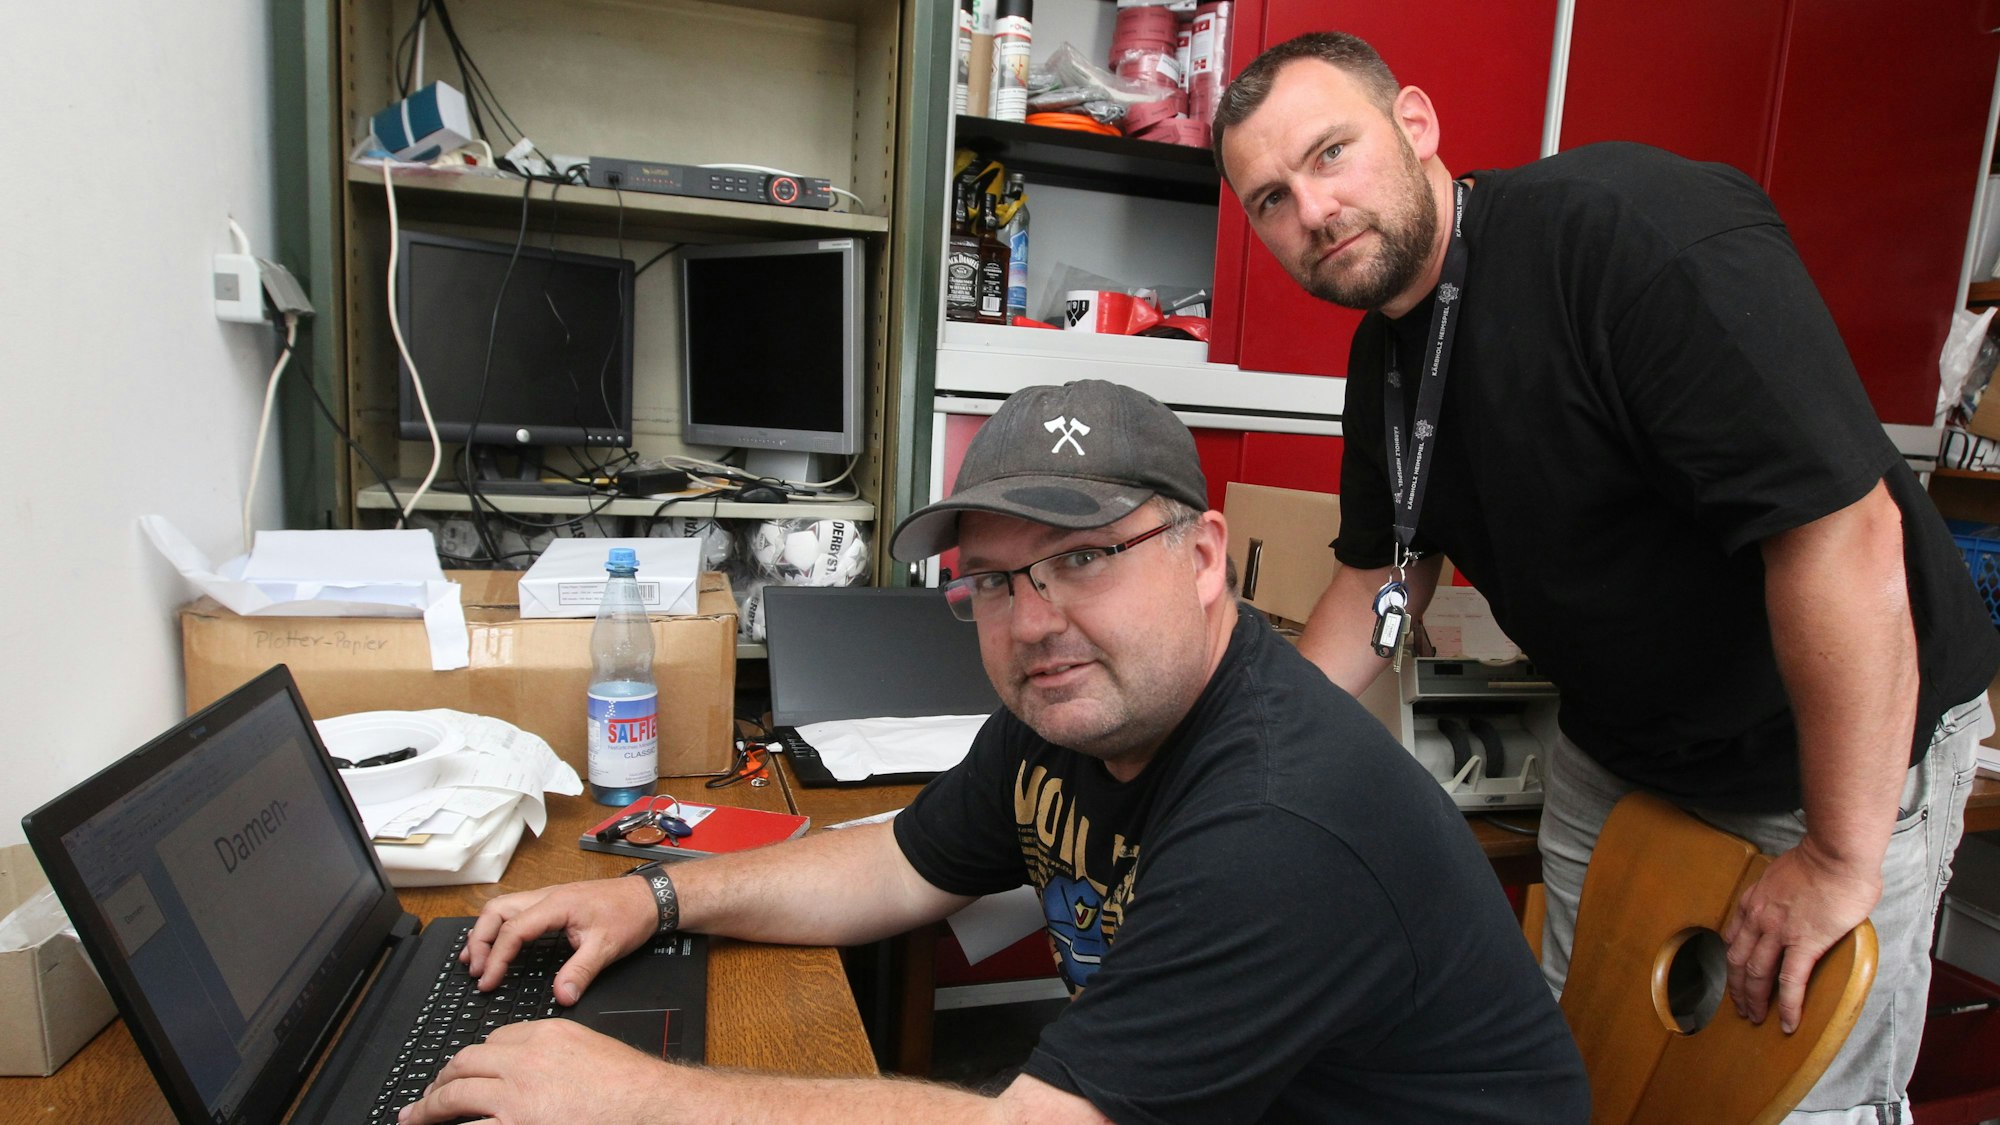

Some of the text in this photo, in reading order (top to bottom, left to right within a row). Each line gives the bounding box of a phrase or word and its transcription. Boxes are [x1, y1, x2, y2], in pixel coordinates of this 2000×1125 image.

[1431, 306, 1450, 377] KÄRBHOLZ HEIMSPIEL
[1407, 441, 1425, 510] KÄRBHOLZ HEIMSPIEL
[253, 629, 389, 656] Plotter-Papier
[213, 800, 289, 873] Damen-
